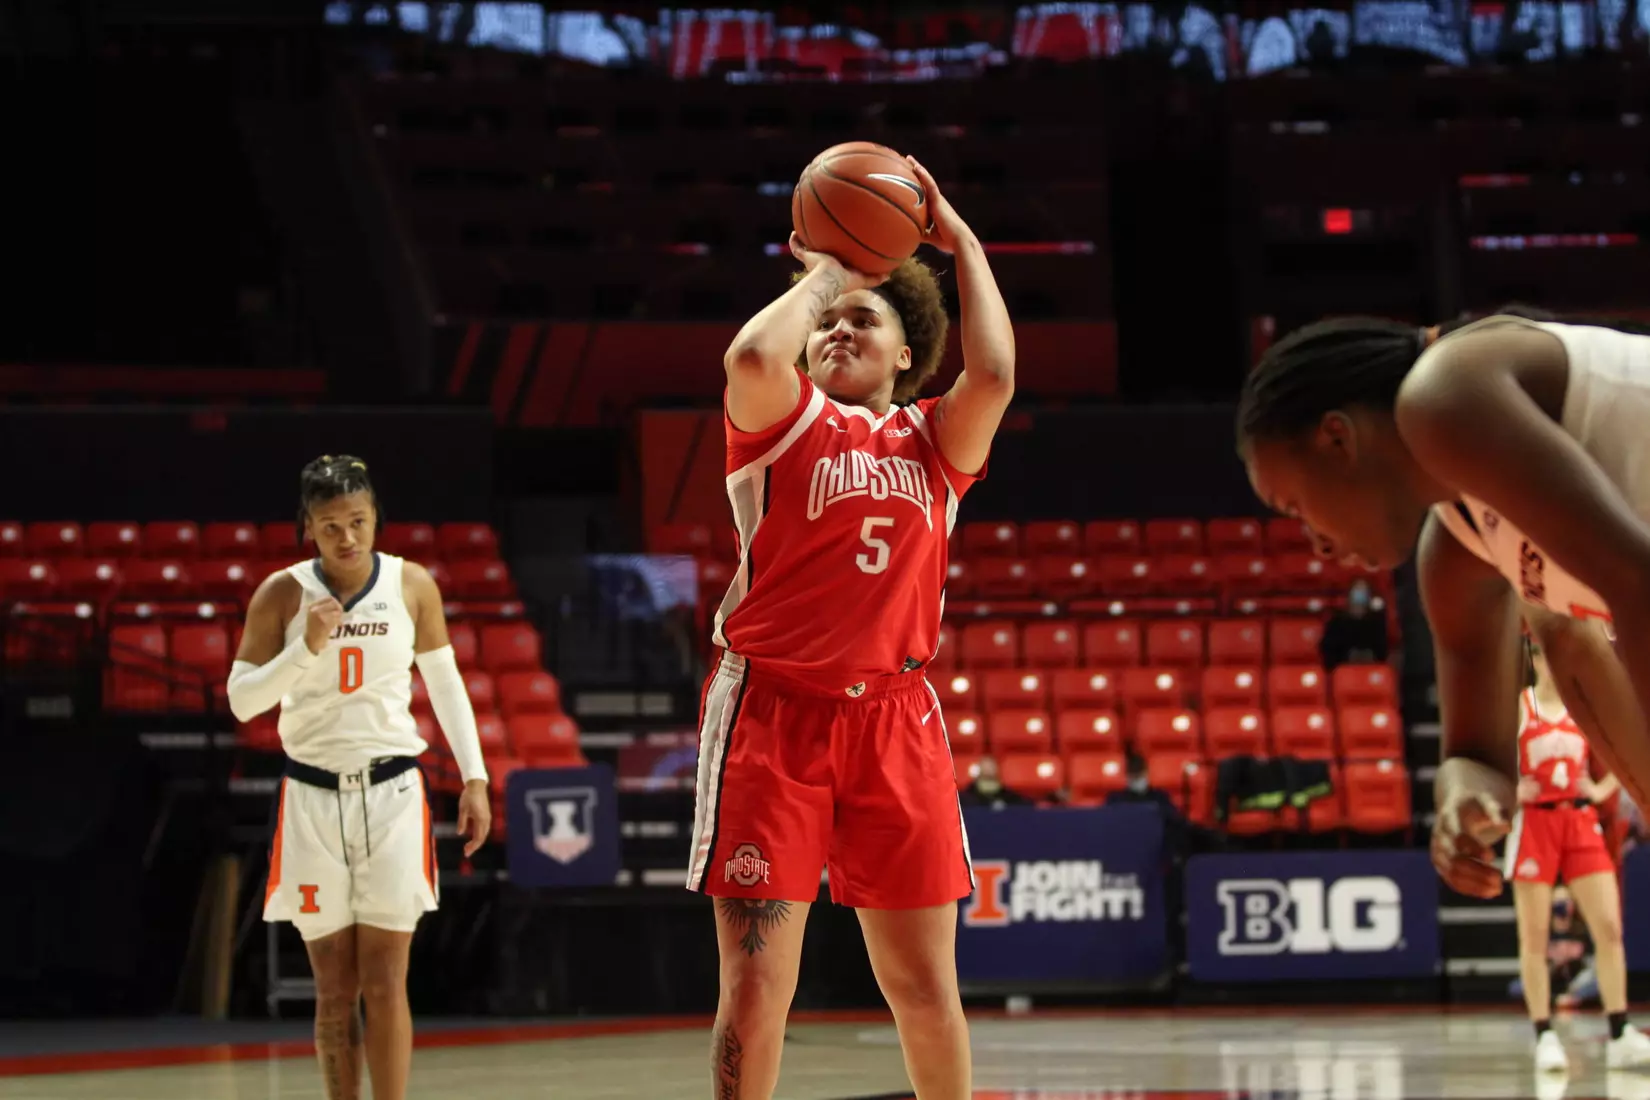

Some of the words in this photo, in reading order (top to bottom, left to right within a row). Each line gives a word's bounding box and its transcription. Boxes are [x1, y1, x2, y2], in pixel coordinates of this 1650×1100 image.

[856, 517, 895, 574] 5
[339, 647, 363, 694] 0
[1014, 861, 1102, 891] JOIN
[1011, 888, 1144, 922] FIGHT!
